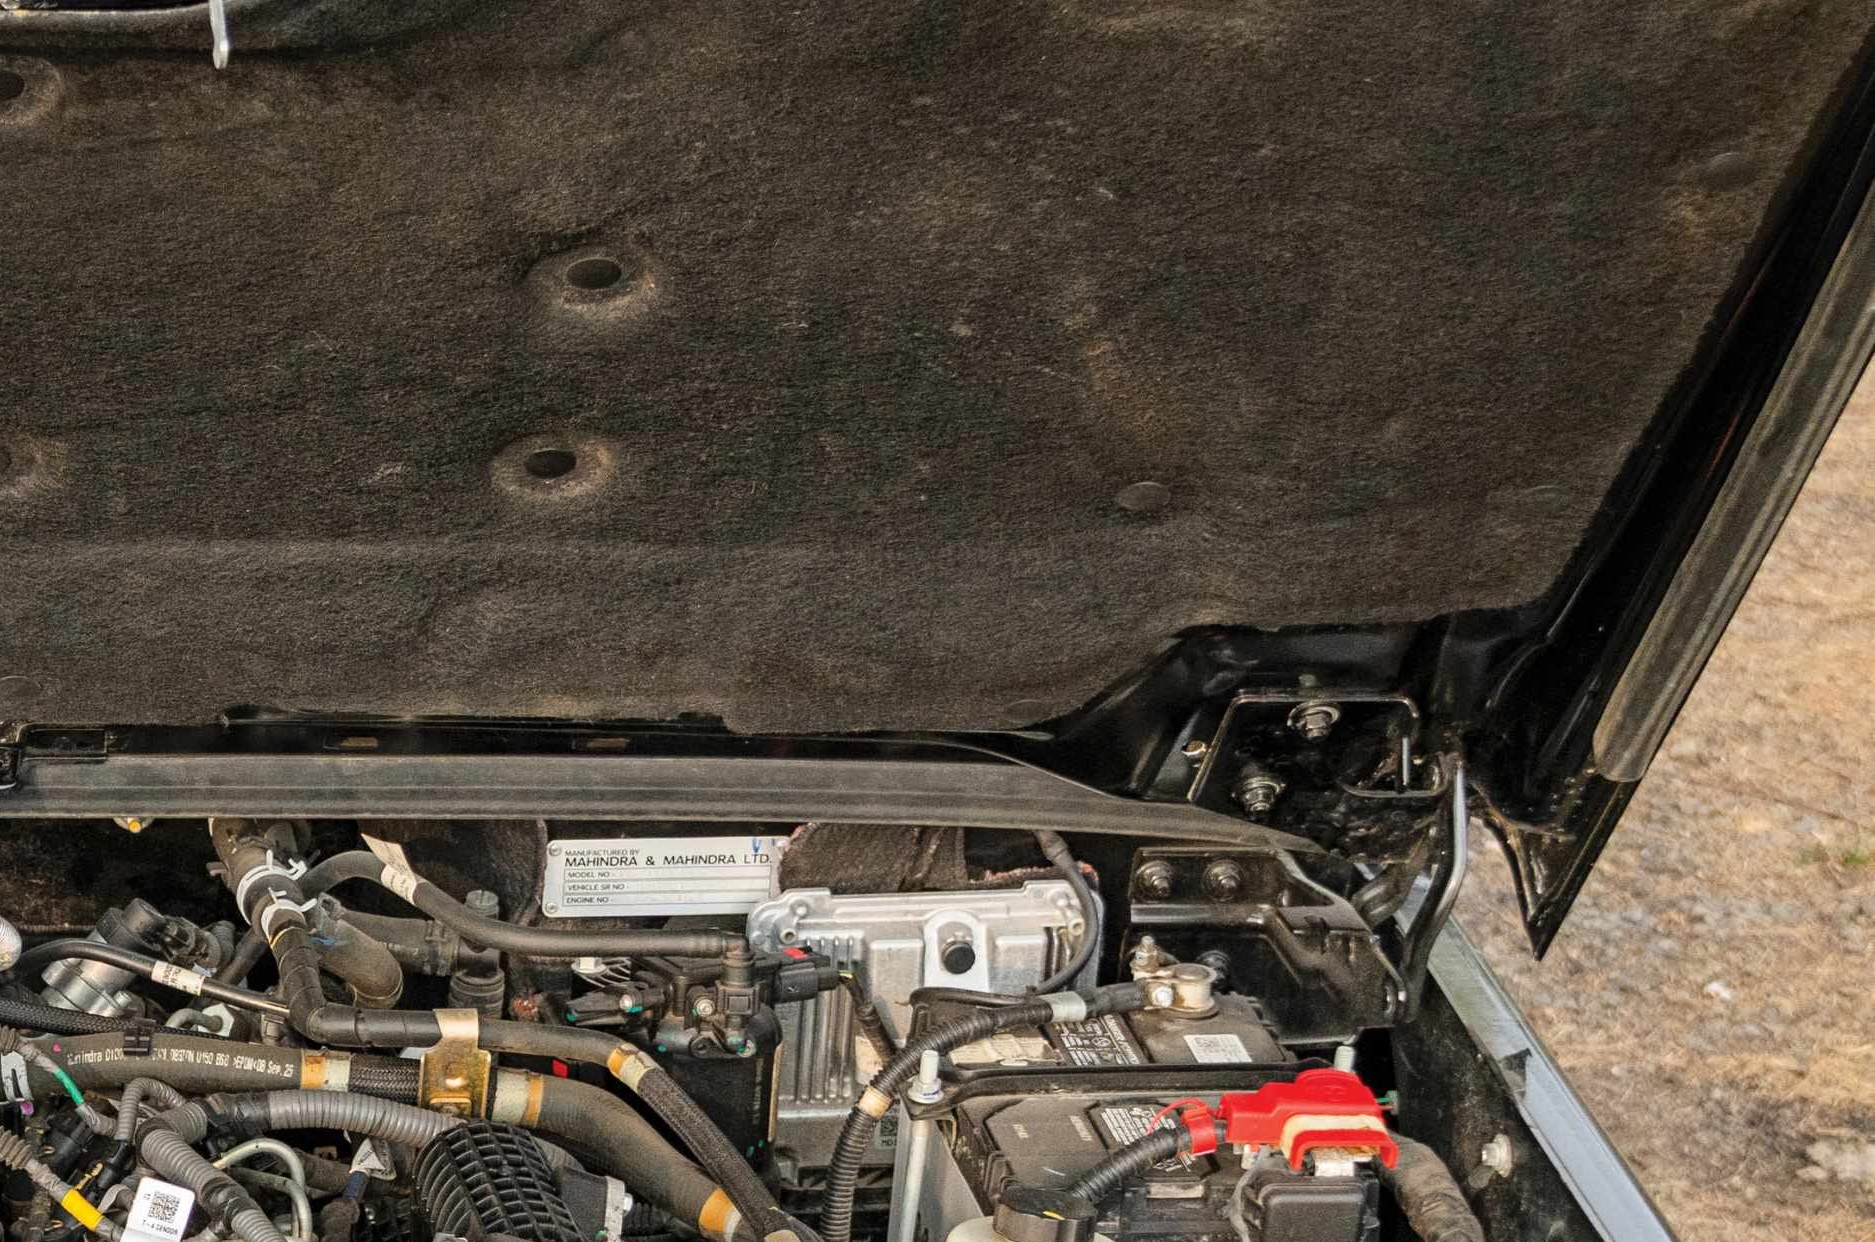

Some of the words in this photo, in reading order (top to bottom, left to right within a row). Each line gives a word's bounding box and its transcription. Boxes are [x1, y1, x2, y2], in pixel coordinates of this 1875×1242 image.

[565, 849, 629, 857] MANUFACTURED
[564, 857, 638, 867] MAHINDRA
[645, 856, 656, 866] &
[662, 855, 737, 865] MAHINDRA
[743, 854, 773, 864] LTD.
